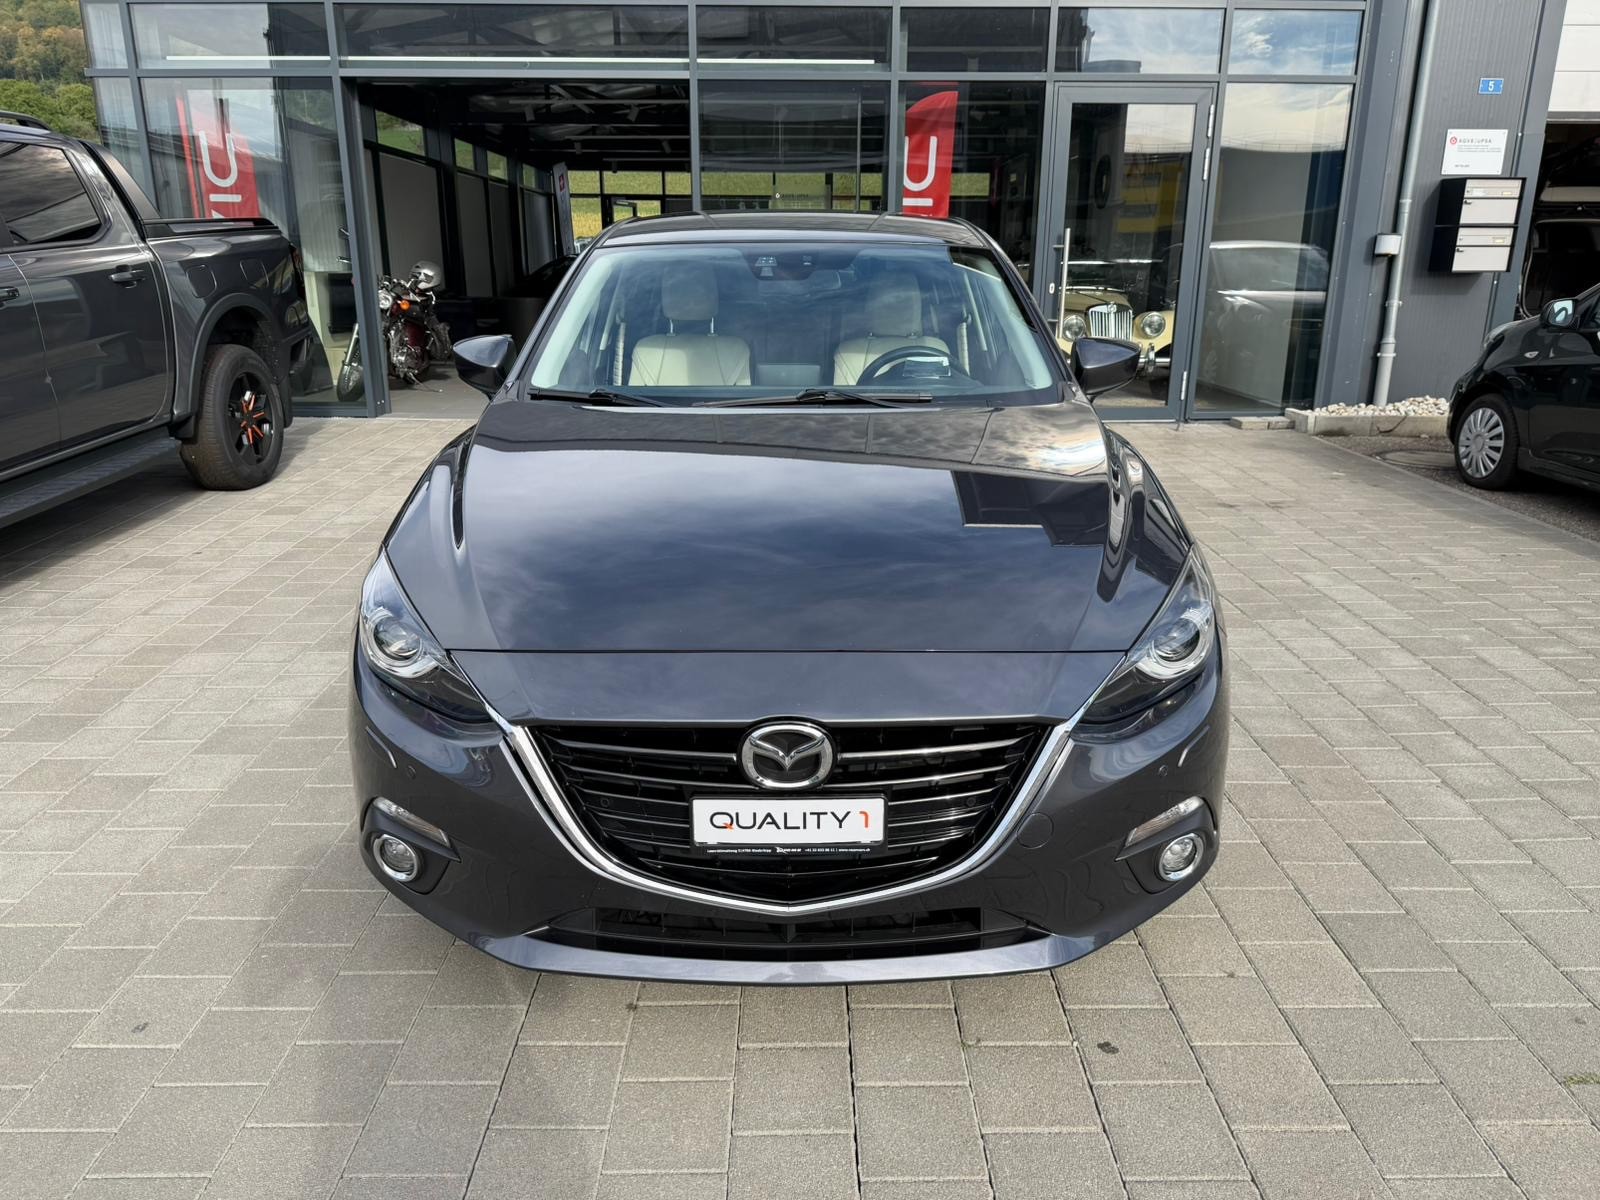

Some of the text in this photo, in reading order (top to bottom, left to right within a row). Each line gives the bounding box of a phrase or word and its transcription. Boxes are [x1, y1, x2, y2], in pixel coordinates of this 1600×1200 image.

[1488, 80, 1495, 91] 5
[709, 811, 869, 830] QUALITY 1
